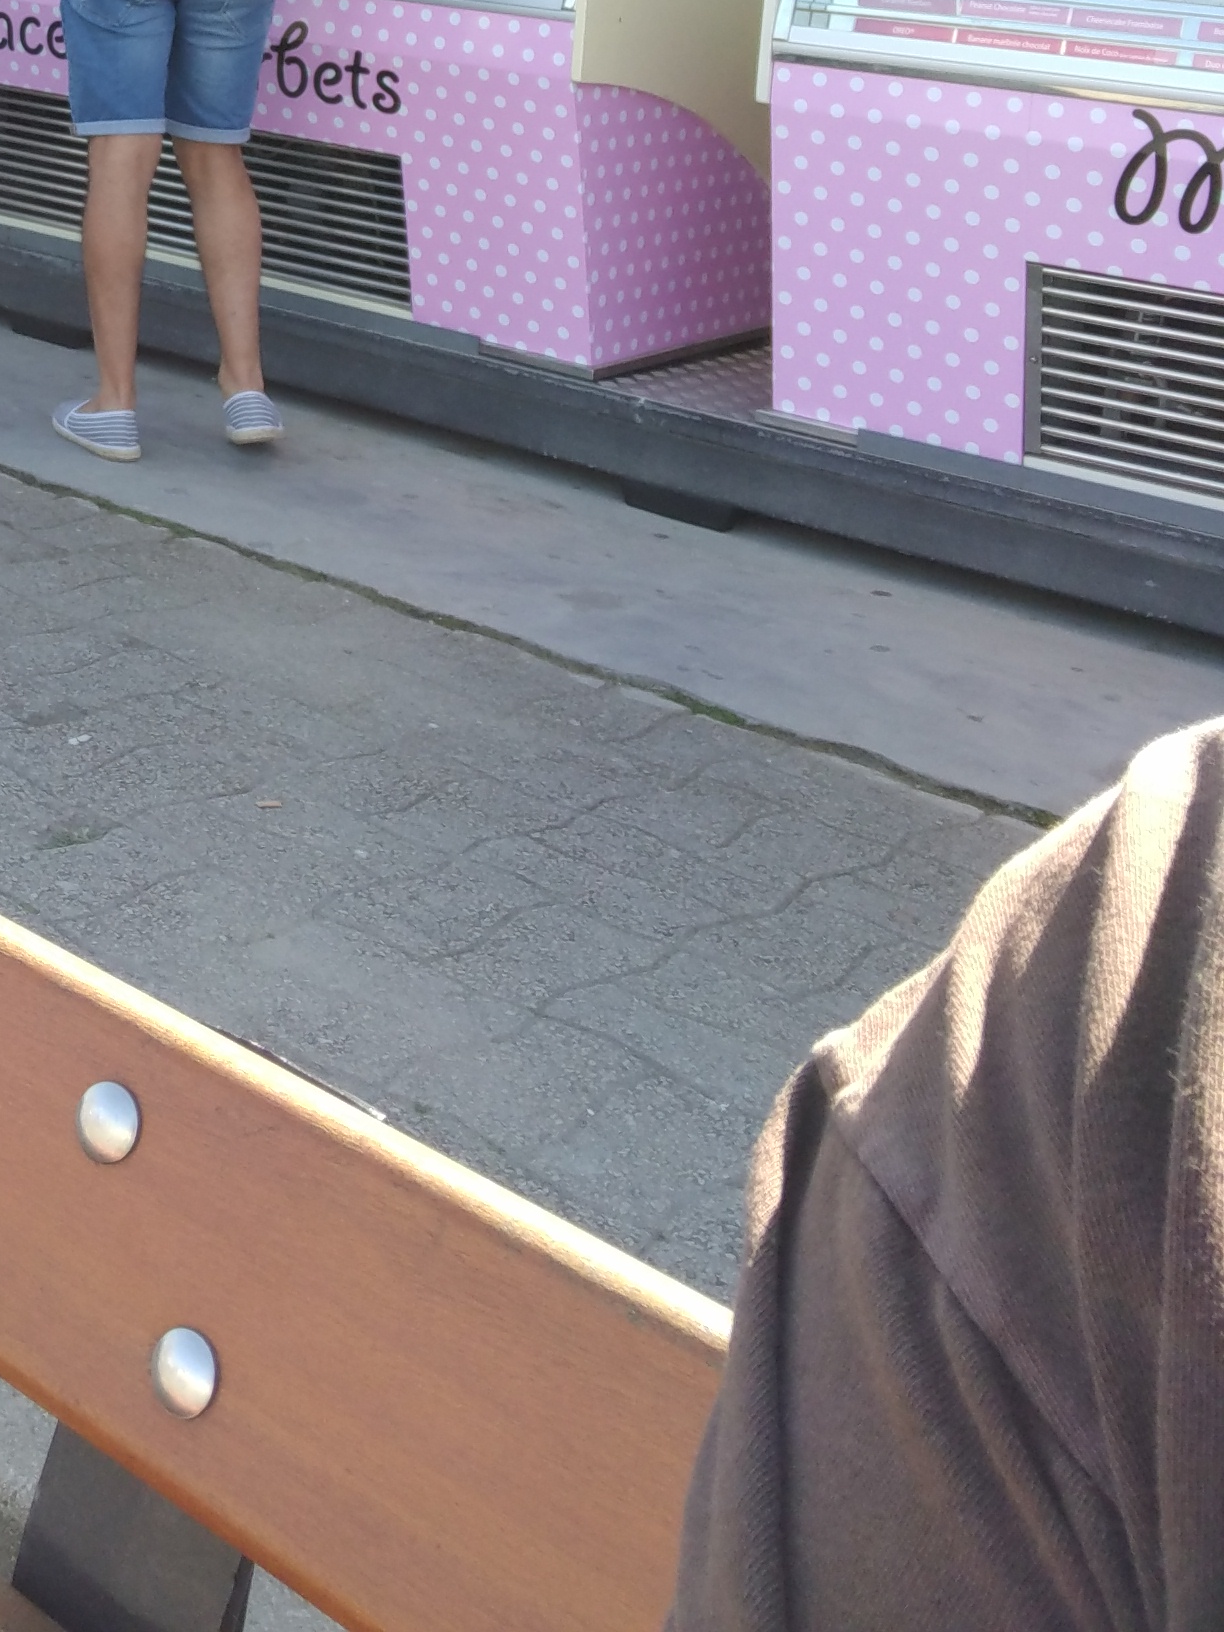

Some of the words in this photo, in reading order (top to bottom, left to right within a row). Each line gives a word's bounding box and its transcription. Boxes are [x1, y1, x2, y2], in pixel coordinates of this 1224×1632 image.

[1074, 44, 1090, 54] Noix
[1091, 46, 1101, 55] de
[1102, 47, 1119, 57] Coco
